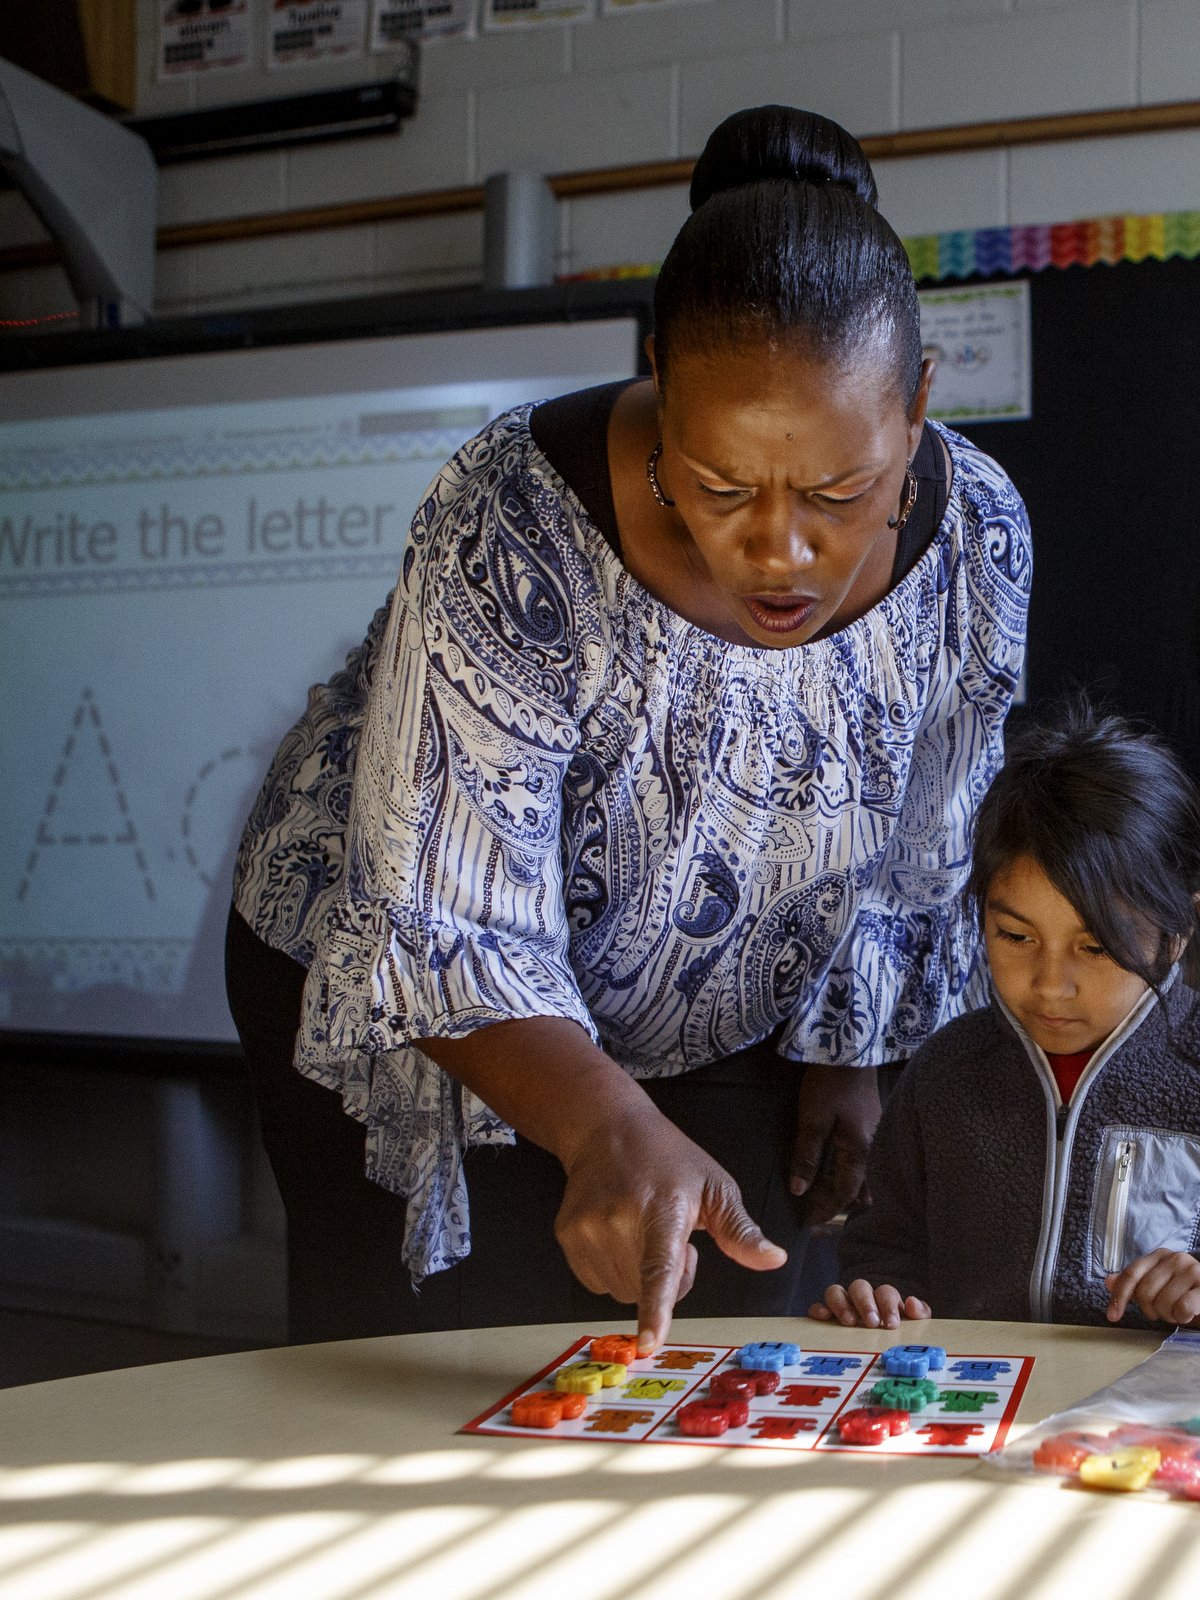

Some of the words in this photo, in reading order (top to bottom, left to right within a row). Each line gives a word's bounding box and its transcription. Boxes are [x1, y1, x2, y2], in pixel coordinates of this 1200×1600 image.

[140, 504, 226, 561] the
[248, 495, 396, 554] letter
[759, 1342, 784, 1350] H
[680, 1351, 698, 1359] X
[821, 1357, 844, 1366] H
[578, 1362, 612, 1372] M
[640, 1379, 673, 1389] M
[893, 1379, 918, 1388] N
[955, 1391, 980, 1401] N
